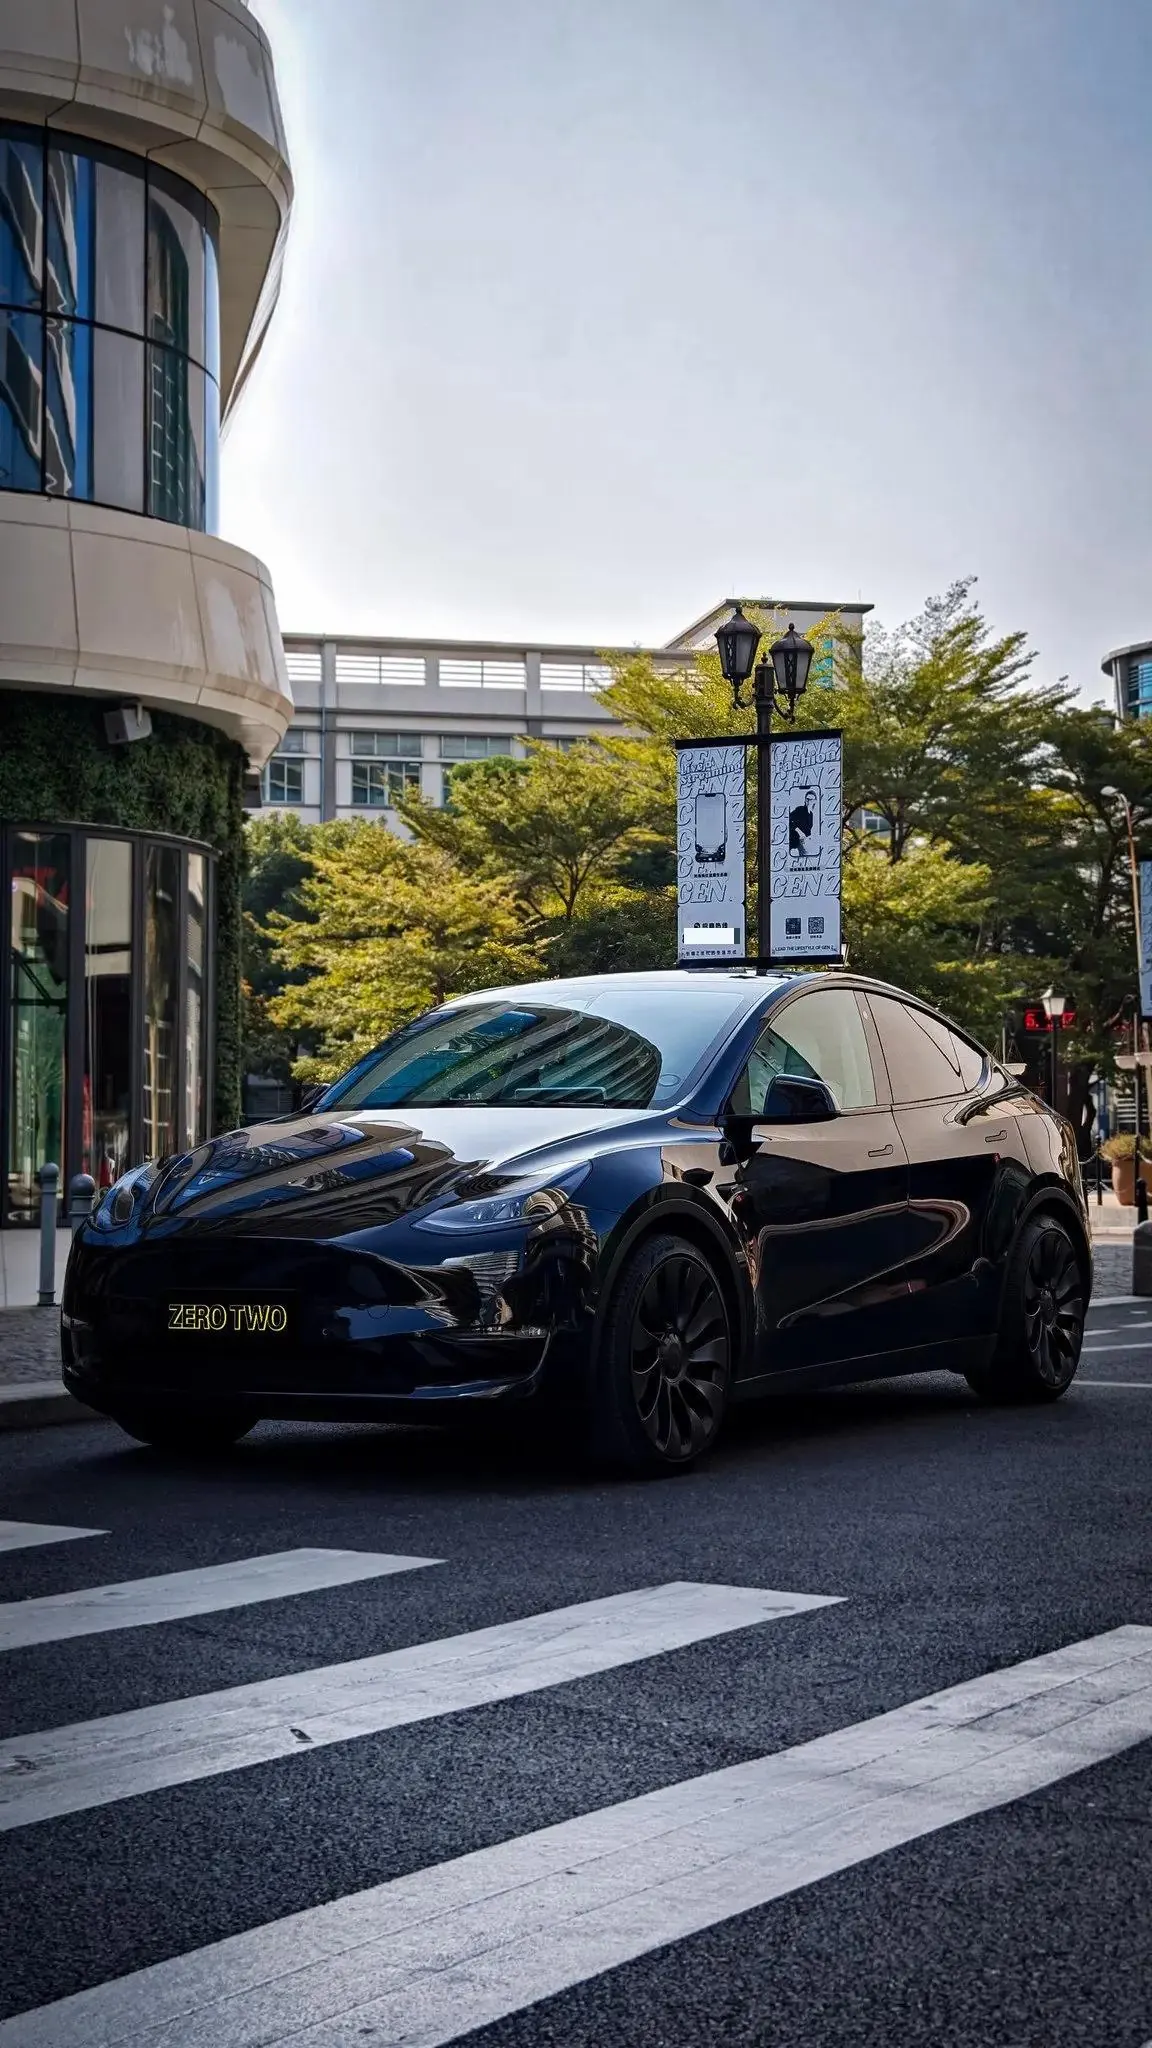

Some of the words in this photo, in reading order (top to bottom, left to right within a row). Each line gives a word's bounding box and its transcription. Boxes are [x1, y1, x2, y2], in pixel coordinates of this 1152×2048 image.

[679, 880, 727, 904] GEN
[771, 873, 824, 898] GEN
[168, 1303, 227, 1330] ZERO
[229, 1304, 287, 1331] TWO
